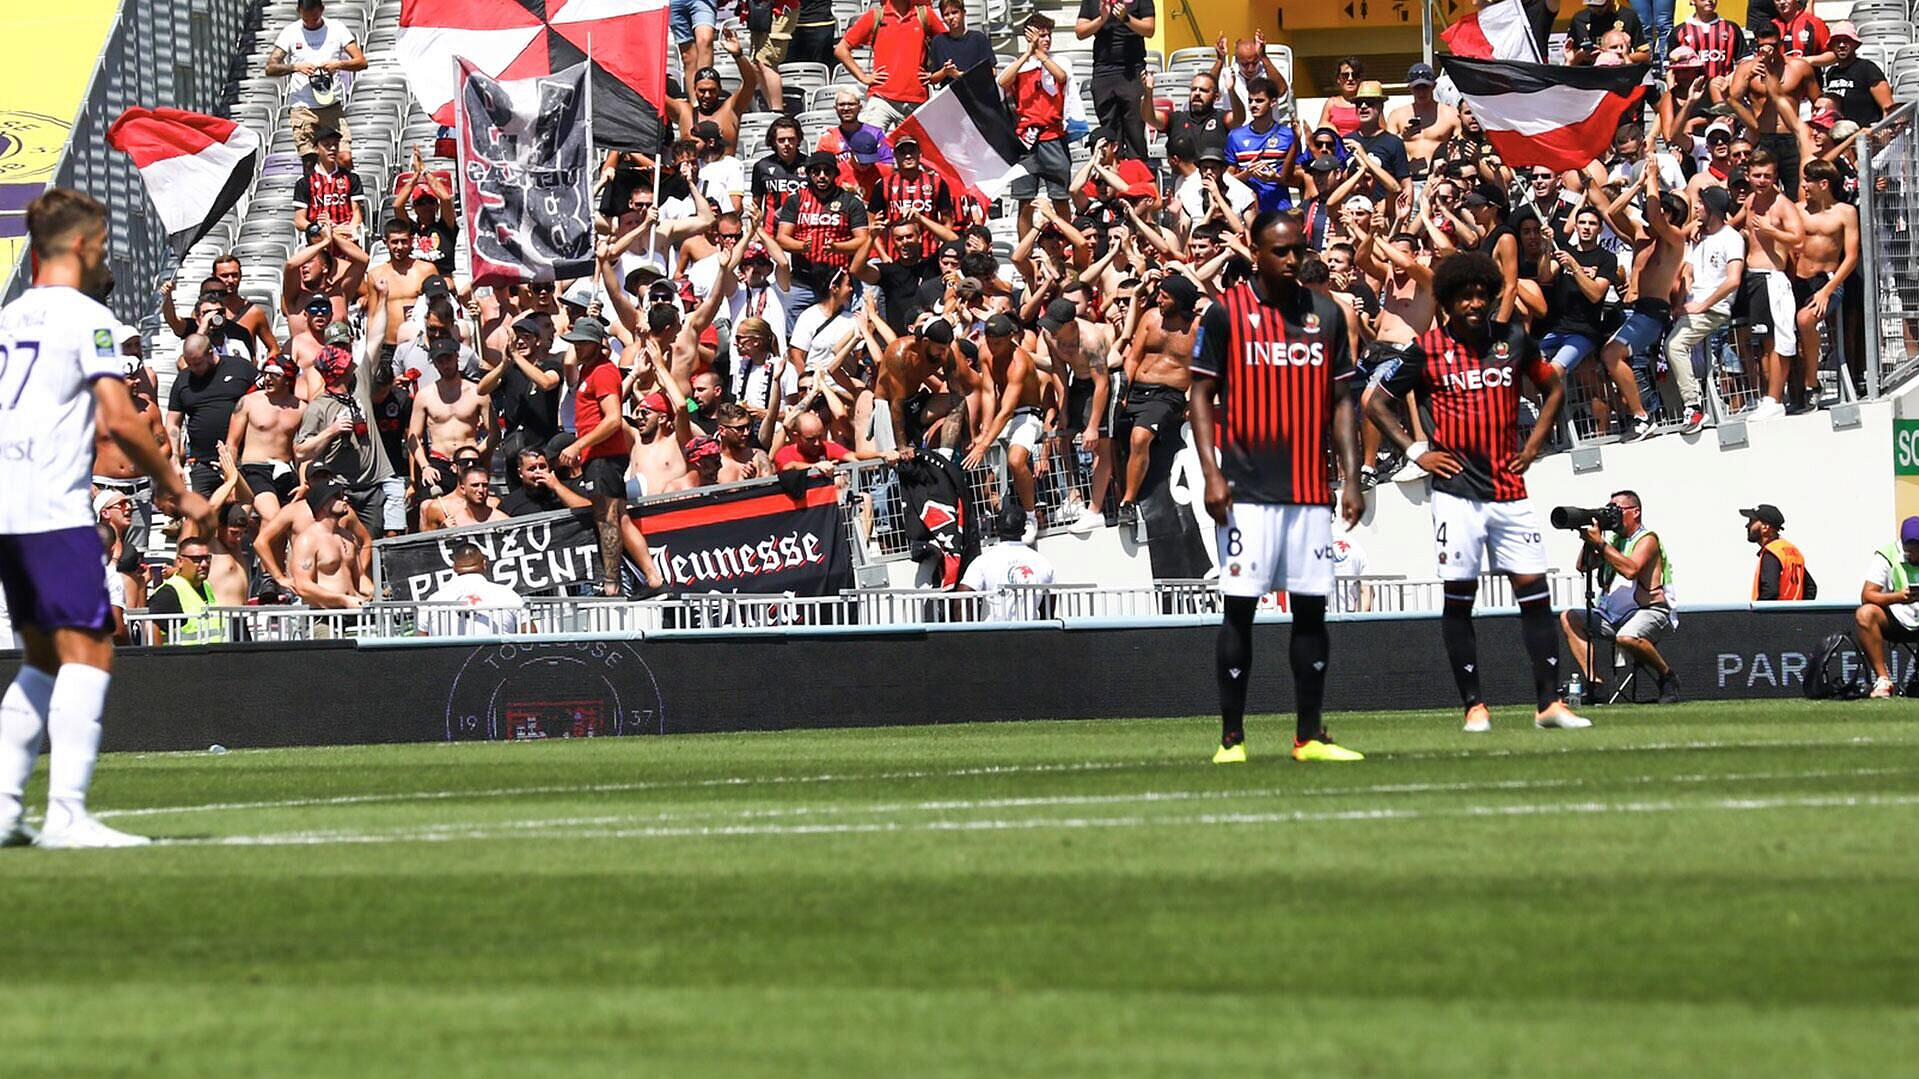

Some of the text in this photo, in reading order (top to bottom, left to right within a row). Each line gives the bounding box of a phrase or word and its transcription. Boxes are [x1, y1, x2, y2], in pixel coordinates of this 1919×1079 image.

[1698, 49, 1726, 62] EOS
[765, 179, 808, 192] INEOS
[890, 199, 932, 214] INEOS
[797, 212, 840, 226] INEOS
[1246, 341, 1324, 367] INEOS
[1443, 366, 1513, 393] INEOS
[1227, 527, 1243, 557] 8
[1436, 521, 1448, 547] 4
[648, 530, 825, 587] Jeunesse
[408, 544, 599, 602] PRSENT
[459, 715, 478, 731] 19
[630, 710, 653, 726] 37
